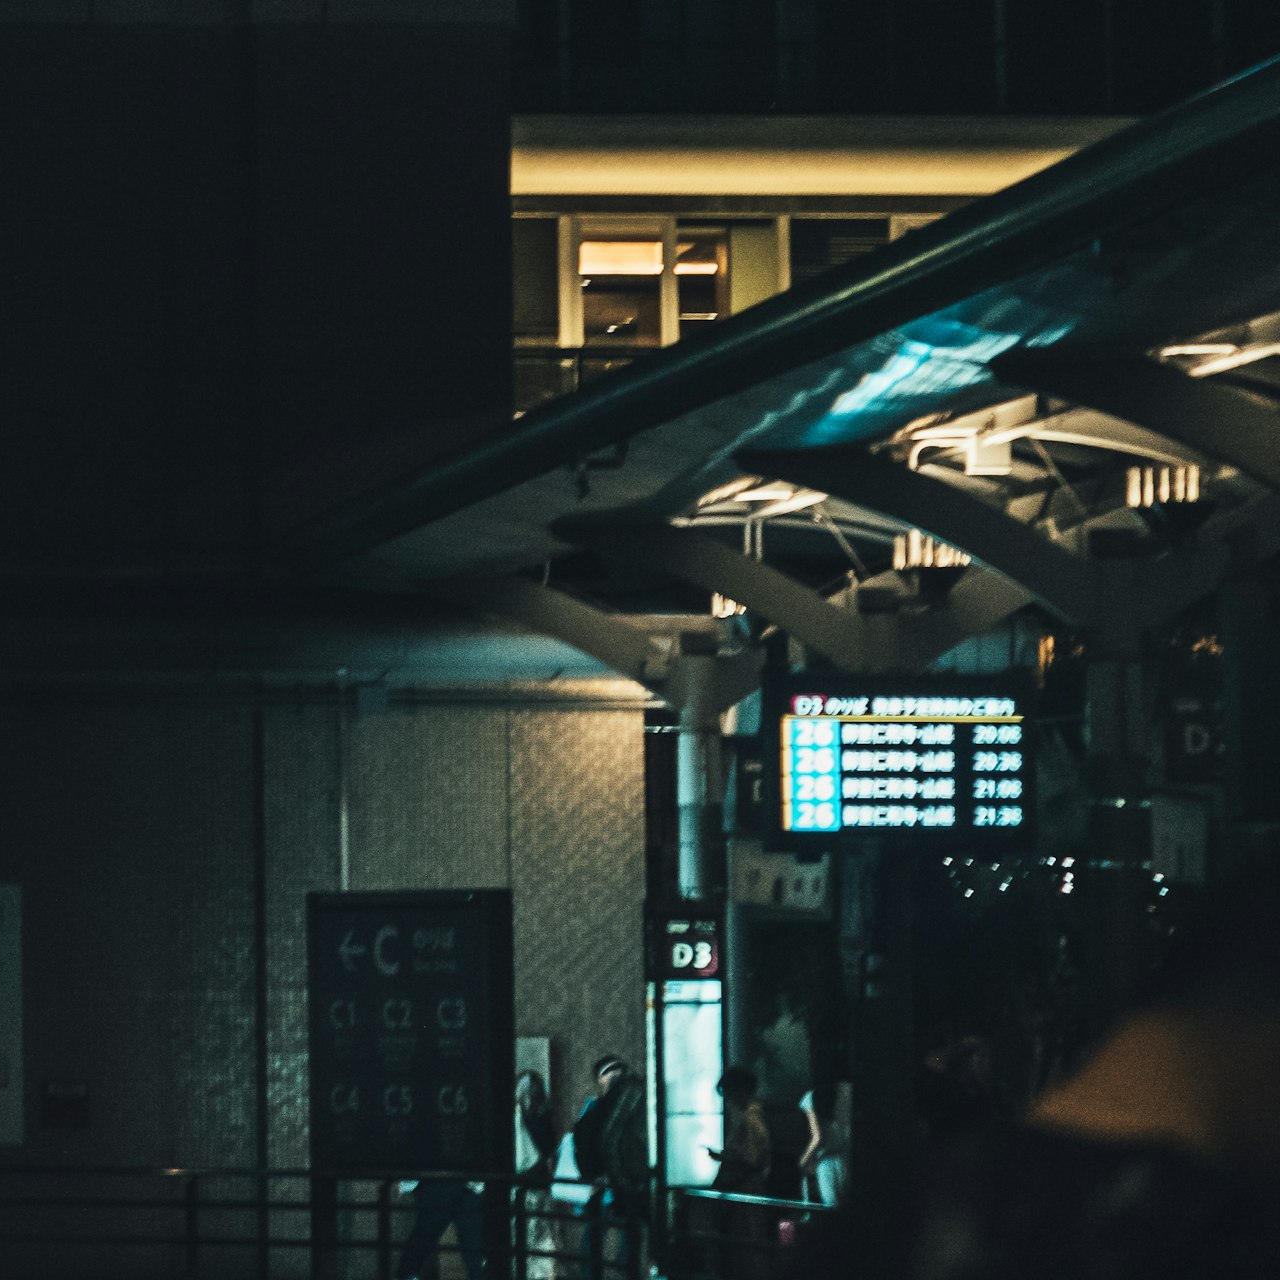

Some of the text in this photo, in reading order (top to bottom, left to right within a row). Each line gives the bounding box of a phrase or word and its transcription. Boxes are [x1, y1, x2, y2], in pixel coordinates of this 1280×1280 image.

[795, 723, 835, 746] 26
[795, 750, 835, 773] 26
[795, 776, 835, 800] 26
[795, 803, 835, 827] 26
[373, 925, 399, 975] C
[672, 941, 713, 969] D3
[330, 998, 467, 1029] C1 C2 C3
[330, 1084, 468, 1115] C4 C5 C6
